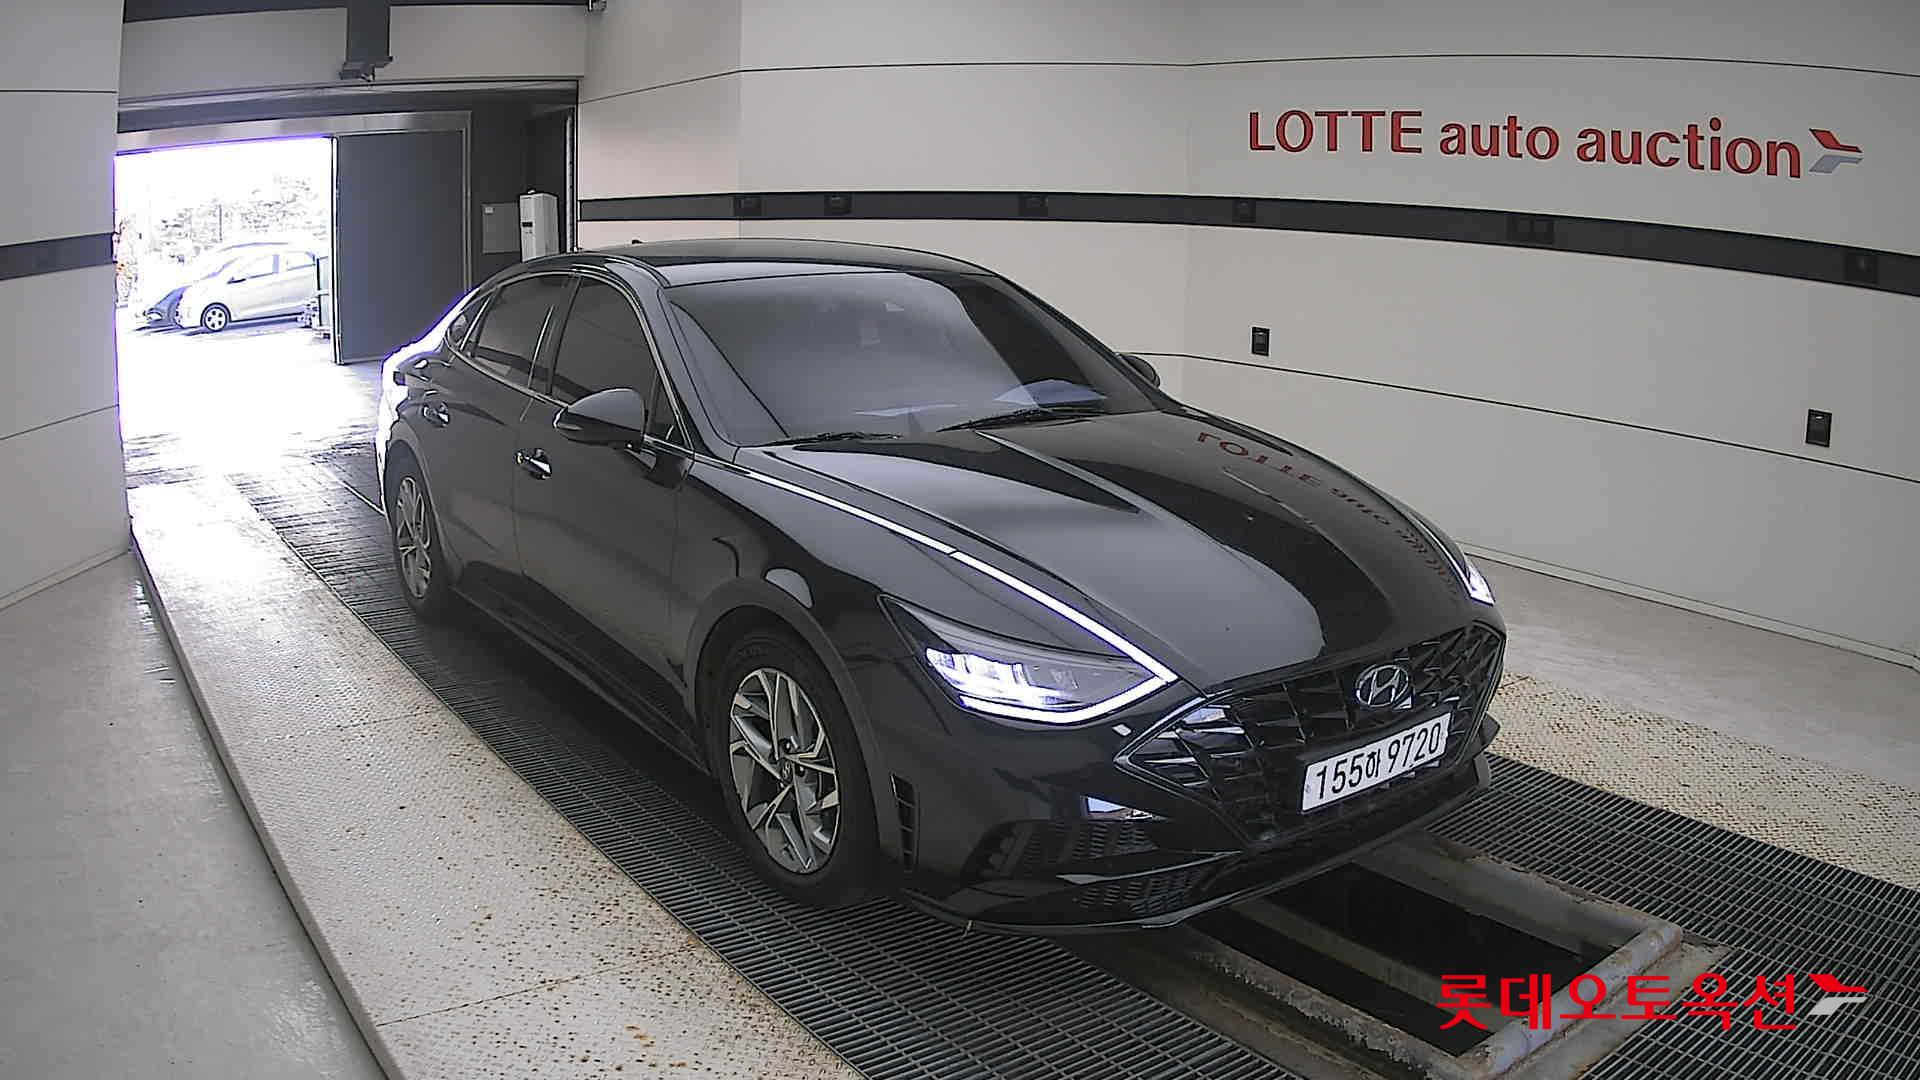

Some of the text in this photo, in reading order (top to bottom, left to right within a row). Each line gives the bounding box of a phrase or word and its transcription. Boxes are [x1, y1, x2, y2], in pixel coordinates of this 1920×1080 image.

[1249, 111, 1801, 178] LOTTE auto auction
[1387, 722, 1442, 774] 9720
